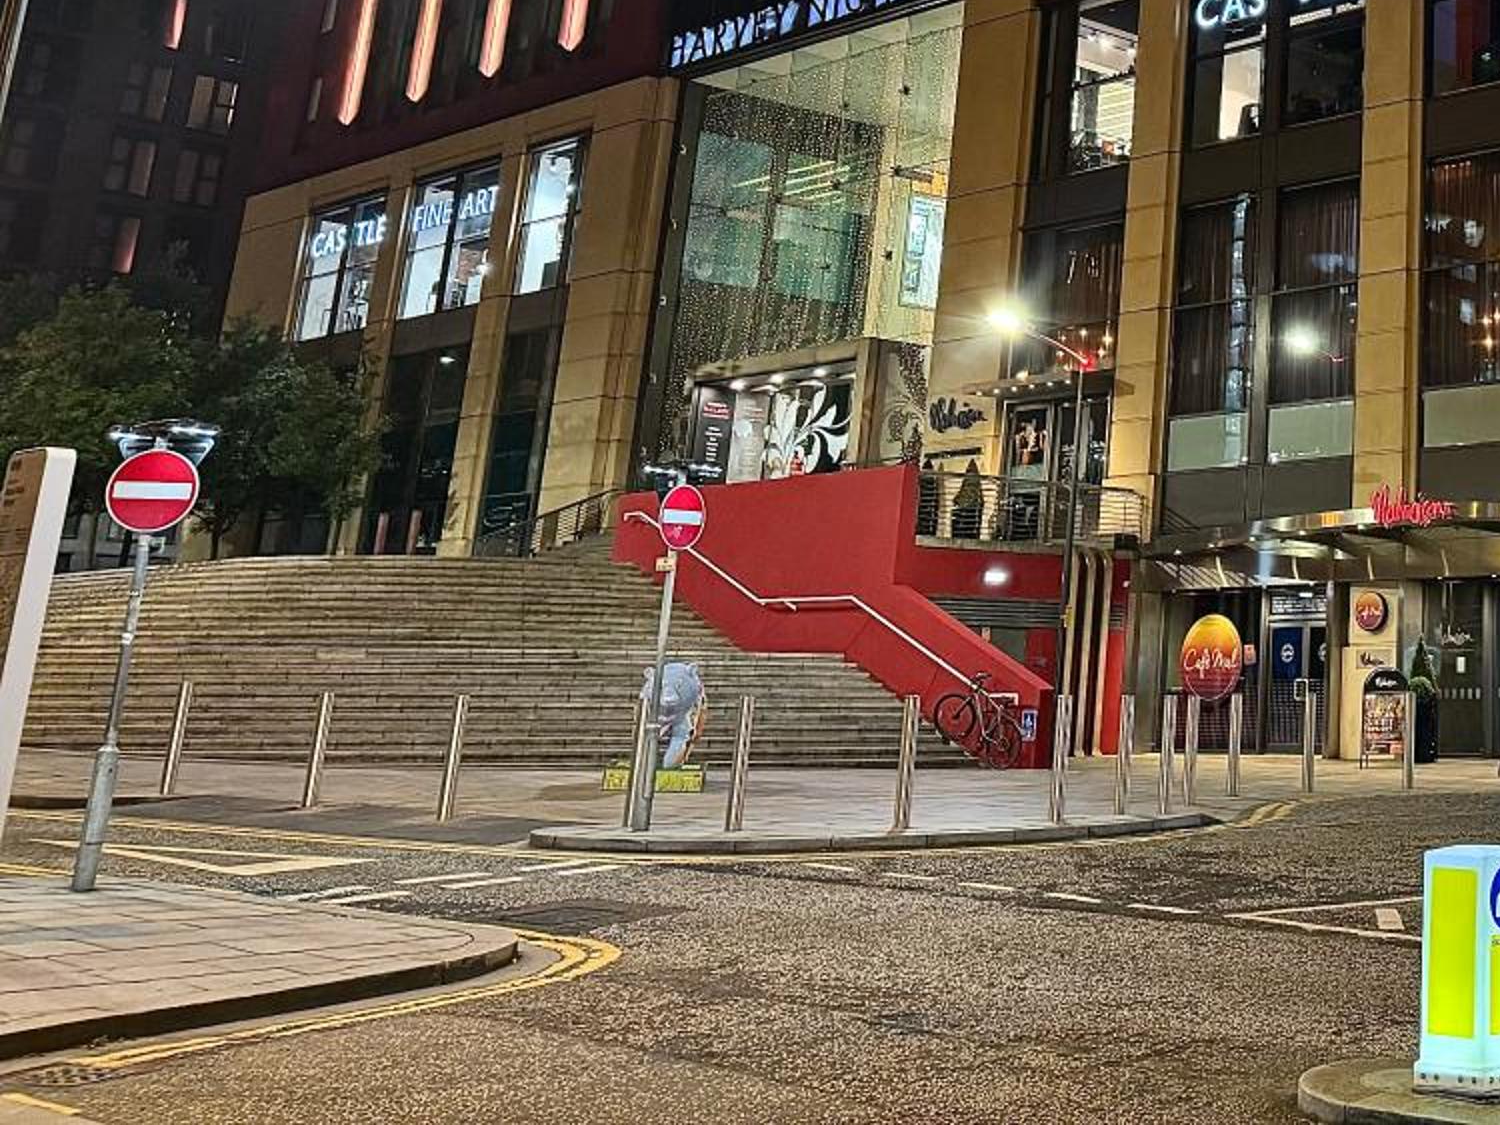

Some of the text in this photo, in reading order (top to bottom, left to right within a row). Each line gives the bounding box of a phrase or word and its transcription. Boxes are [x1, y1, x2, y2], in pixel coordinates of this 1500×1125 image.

[413, 199, 455, 232] FINE
[458, 184, 500, 220] ART
[1211, 648, 1238, 669] Mal
